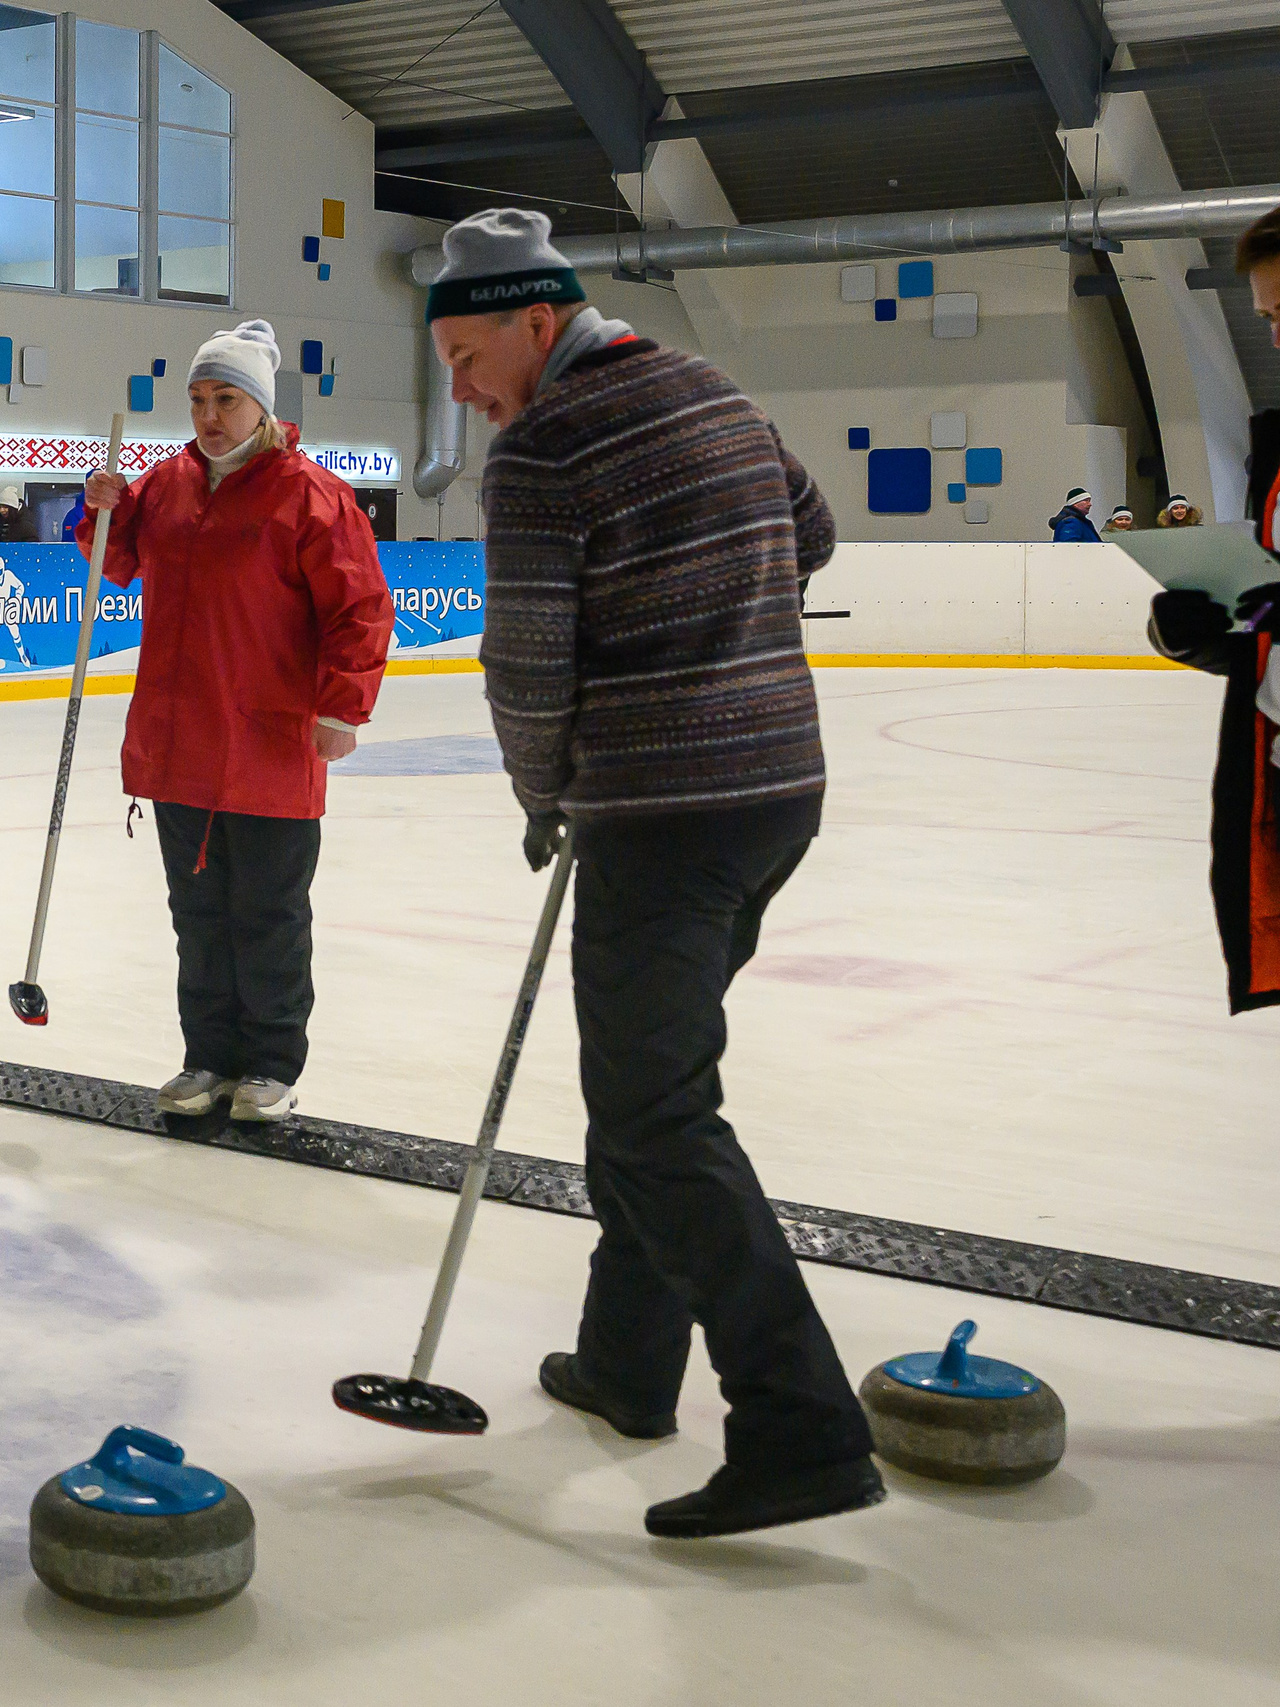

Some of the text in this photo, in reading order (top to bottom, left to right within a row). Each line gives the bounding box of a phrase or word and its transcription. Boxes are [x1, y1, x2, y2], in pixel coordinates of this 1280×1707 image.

[470, 278, 562, 302] БЕЛАРУСЬ
[316, 450, 393, 476] silichy.by
[65, 586, 143, 623] Пези
[392, 586, 483, 620] ларусь
